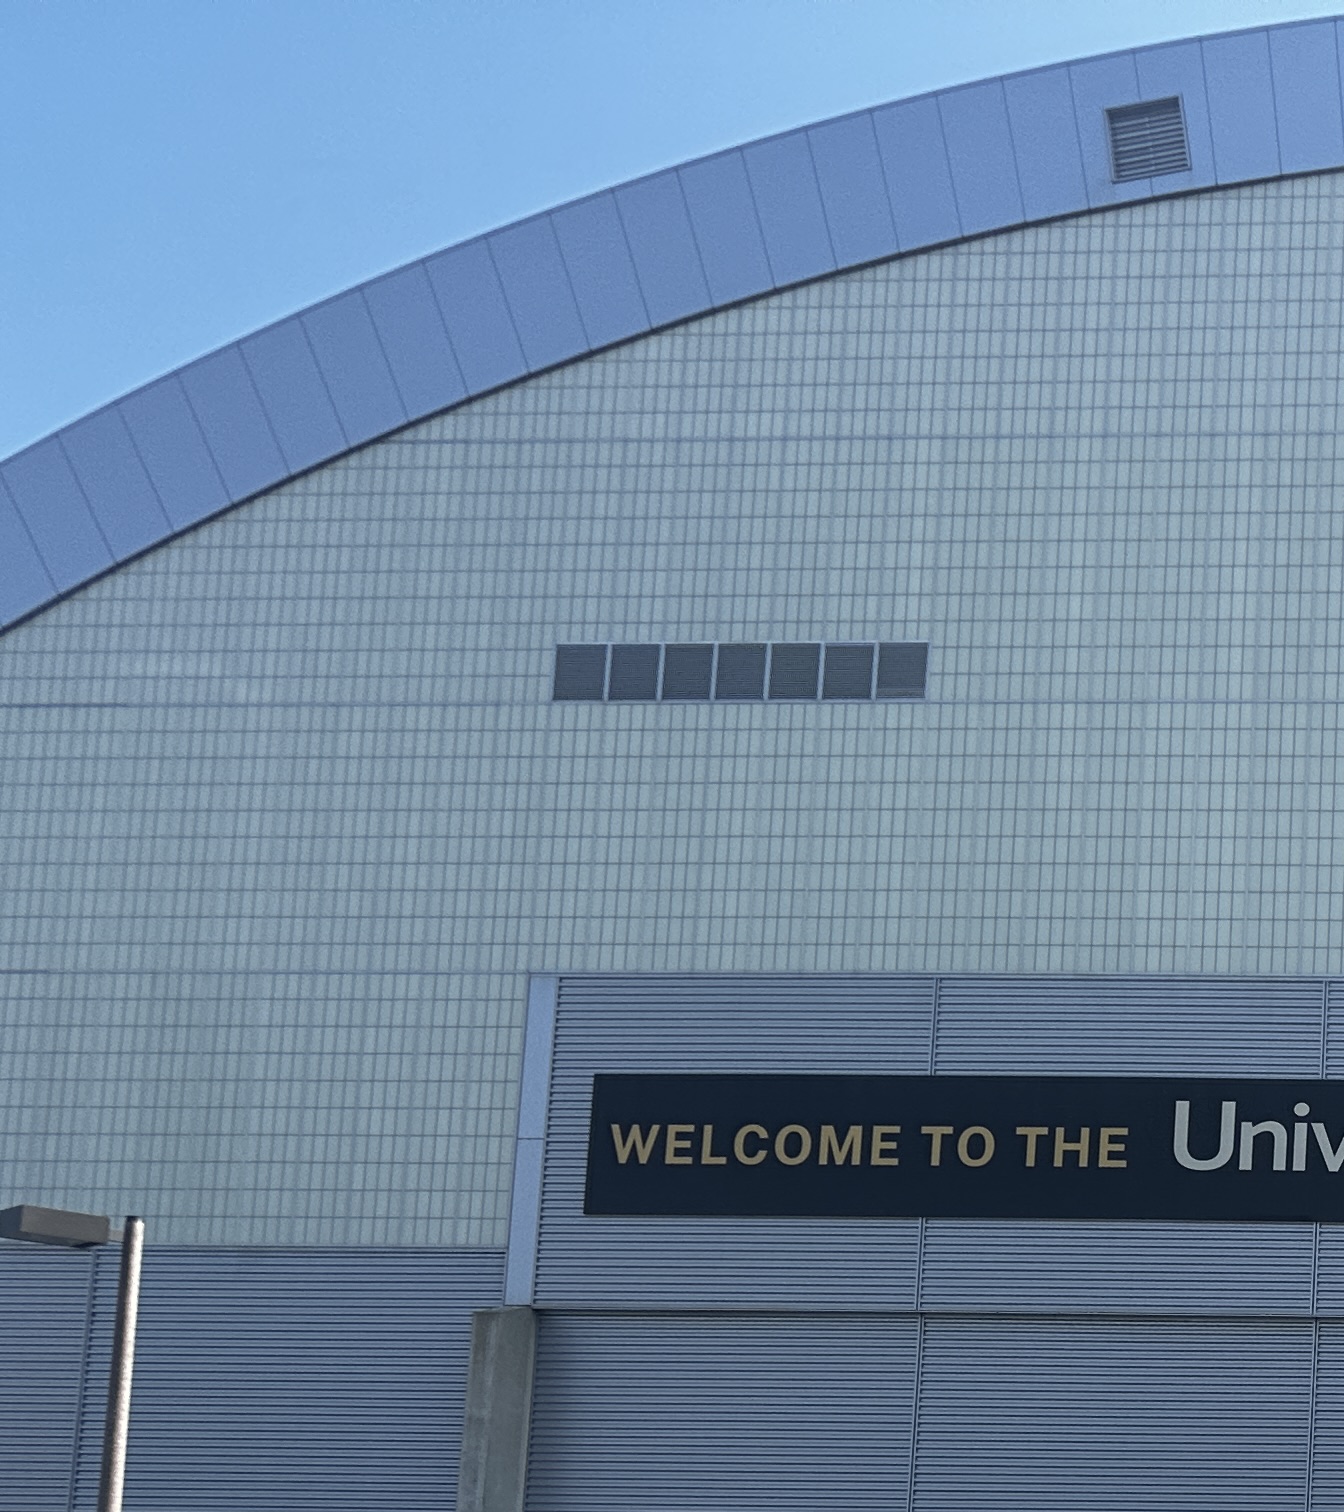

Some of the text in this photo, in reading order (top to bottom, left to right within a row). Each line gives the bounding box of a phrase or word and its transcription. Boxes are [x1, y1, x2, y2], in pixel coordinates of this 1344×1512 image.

[610, 1122, 901, 1166] WELCOME
[921, 1125, 996, 1168] TO
[1016, 1125, 1130, 1169] THE
